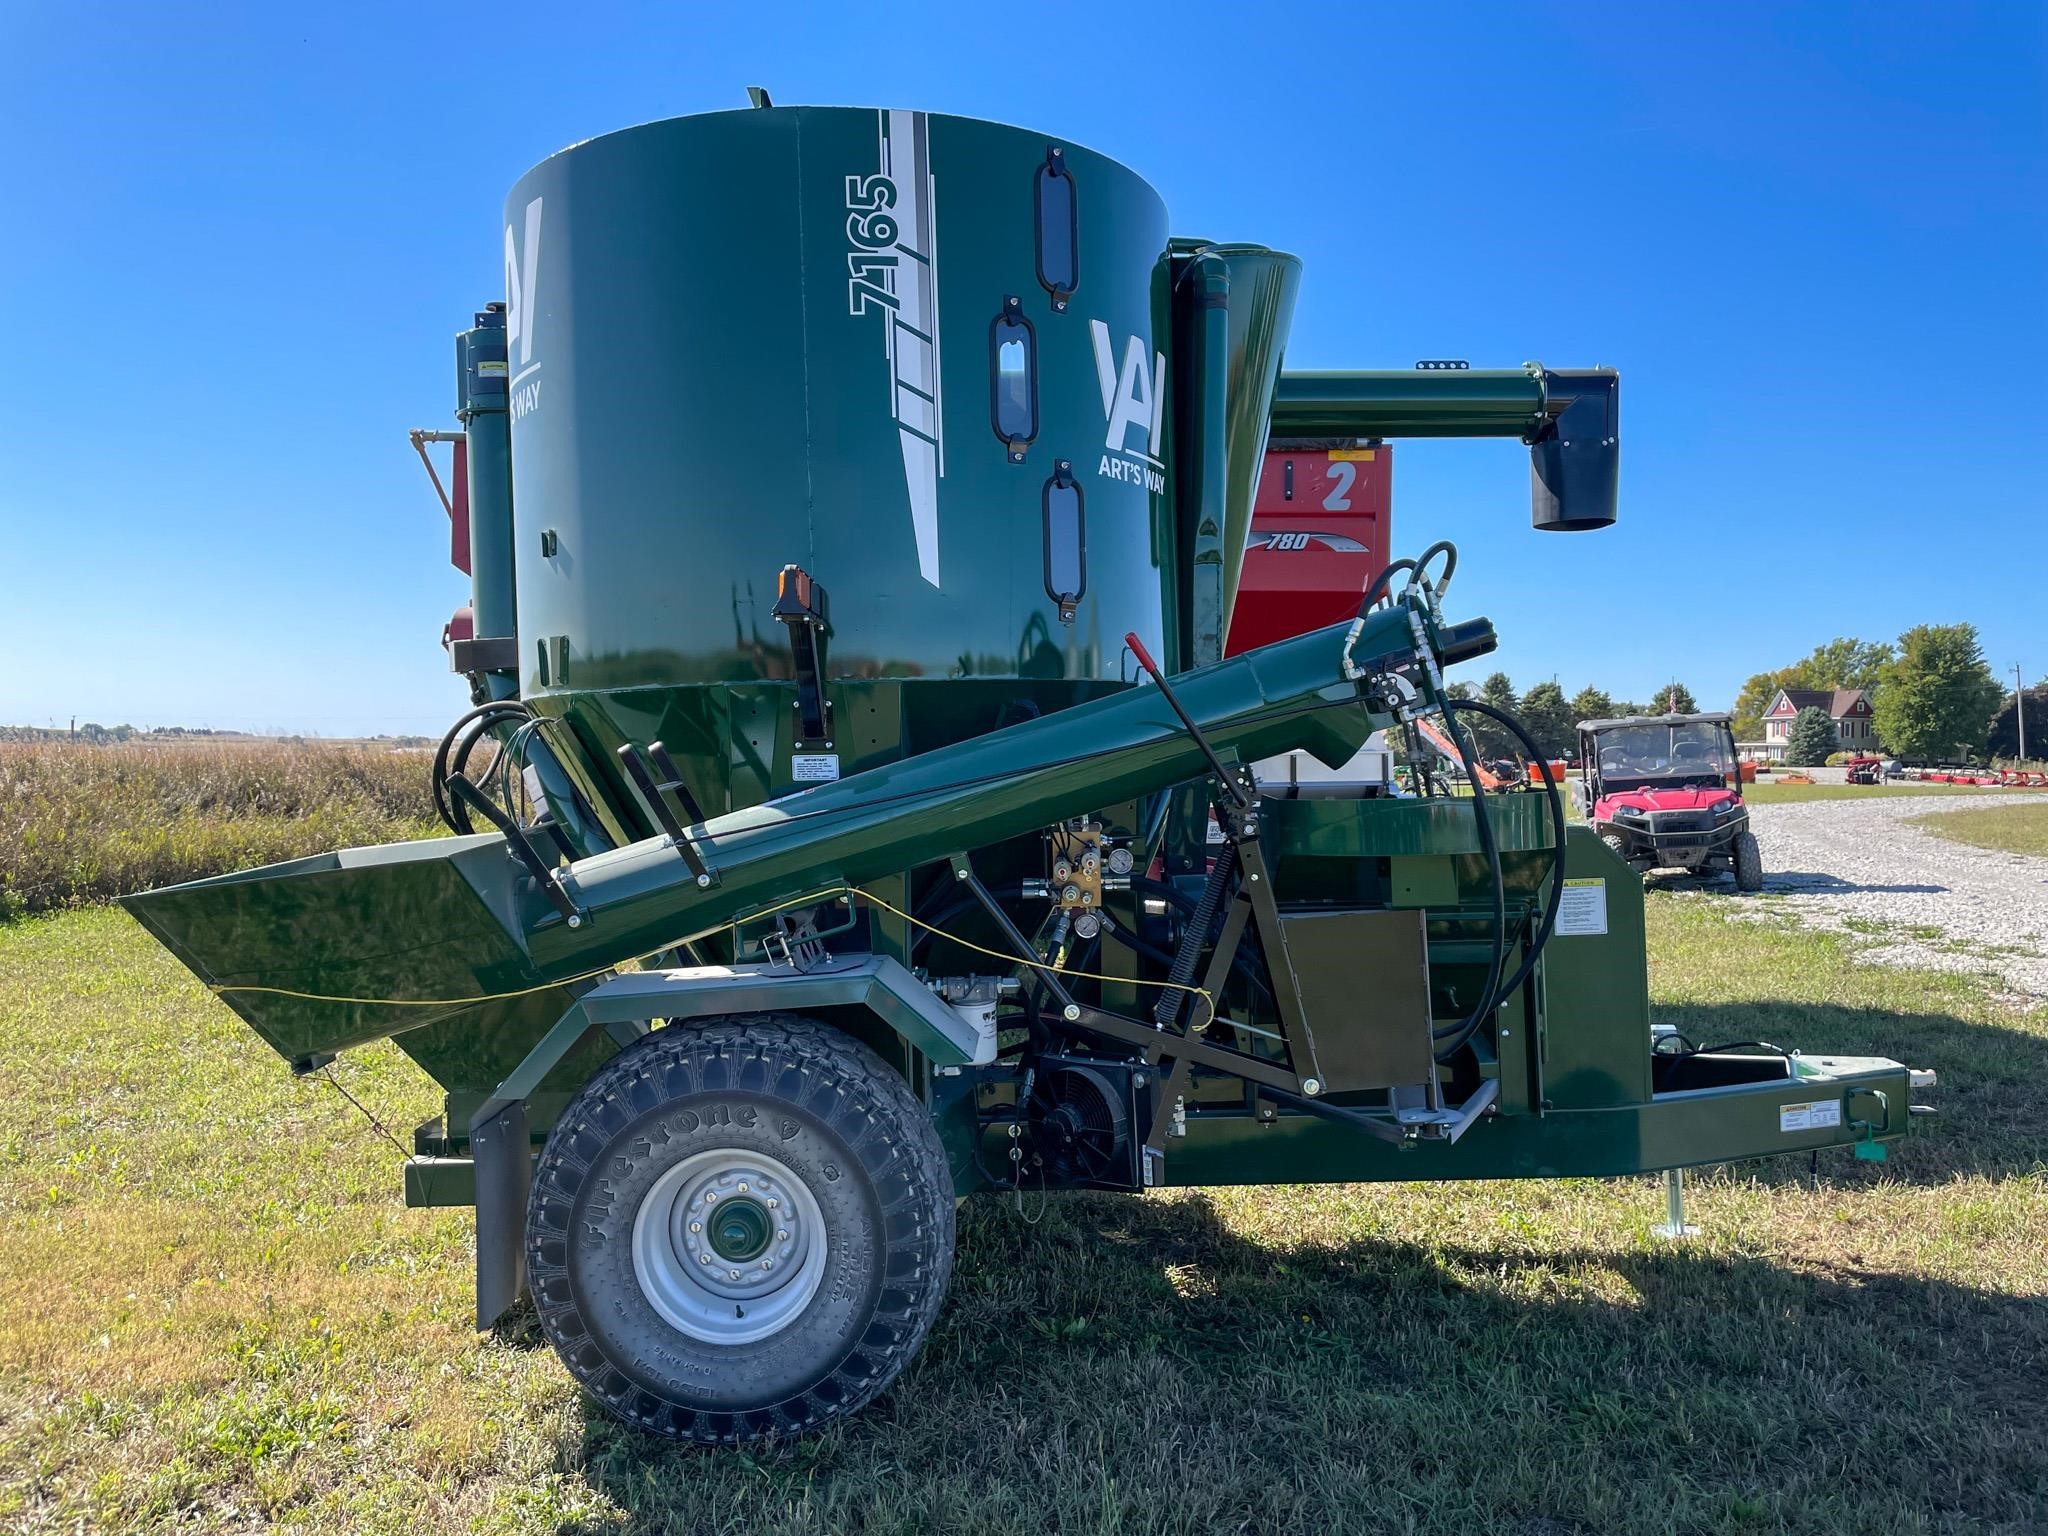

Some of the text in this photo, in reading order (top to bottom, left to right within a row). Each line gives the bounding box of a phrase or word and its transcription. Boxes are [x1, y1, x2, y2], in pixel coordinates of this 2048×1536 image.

[845, 173, 901, 316] 7165
[516, 380, 541, 420] WAY
[1098, 455, 1166, 496] ART'S WAY
[1322, 461, 1357, 511] 2
[1265, 533, 1311, 551] 780
[578, 1103, 759, 1249] Firestone
